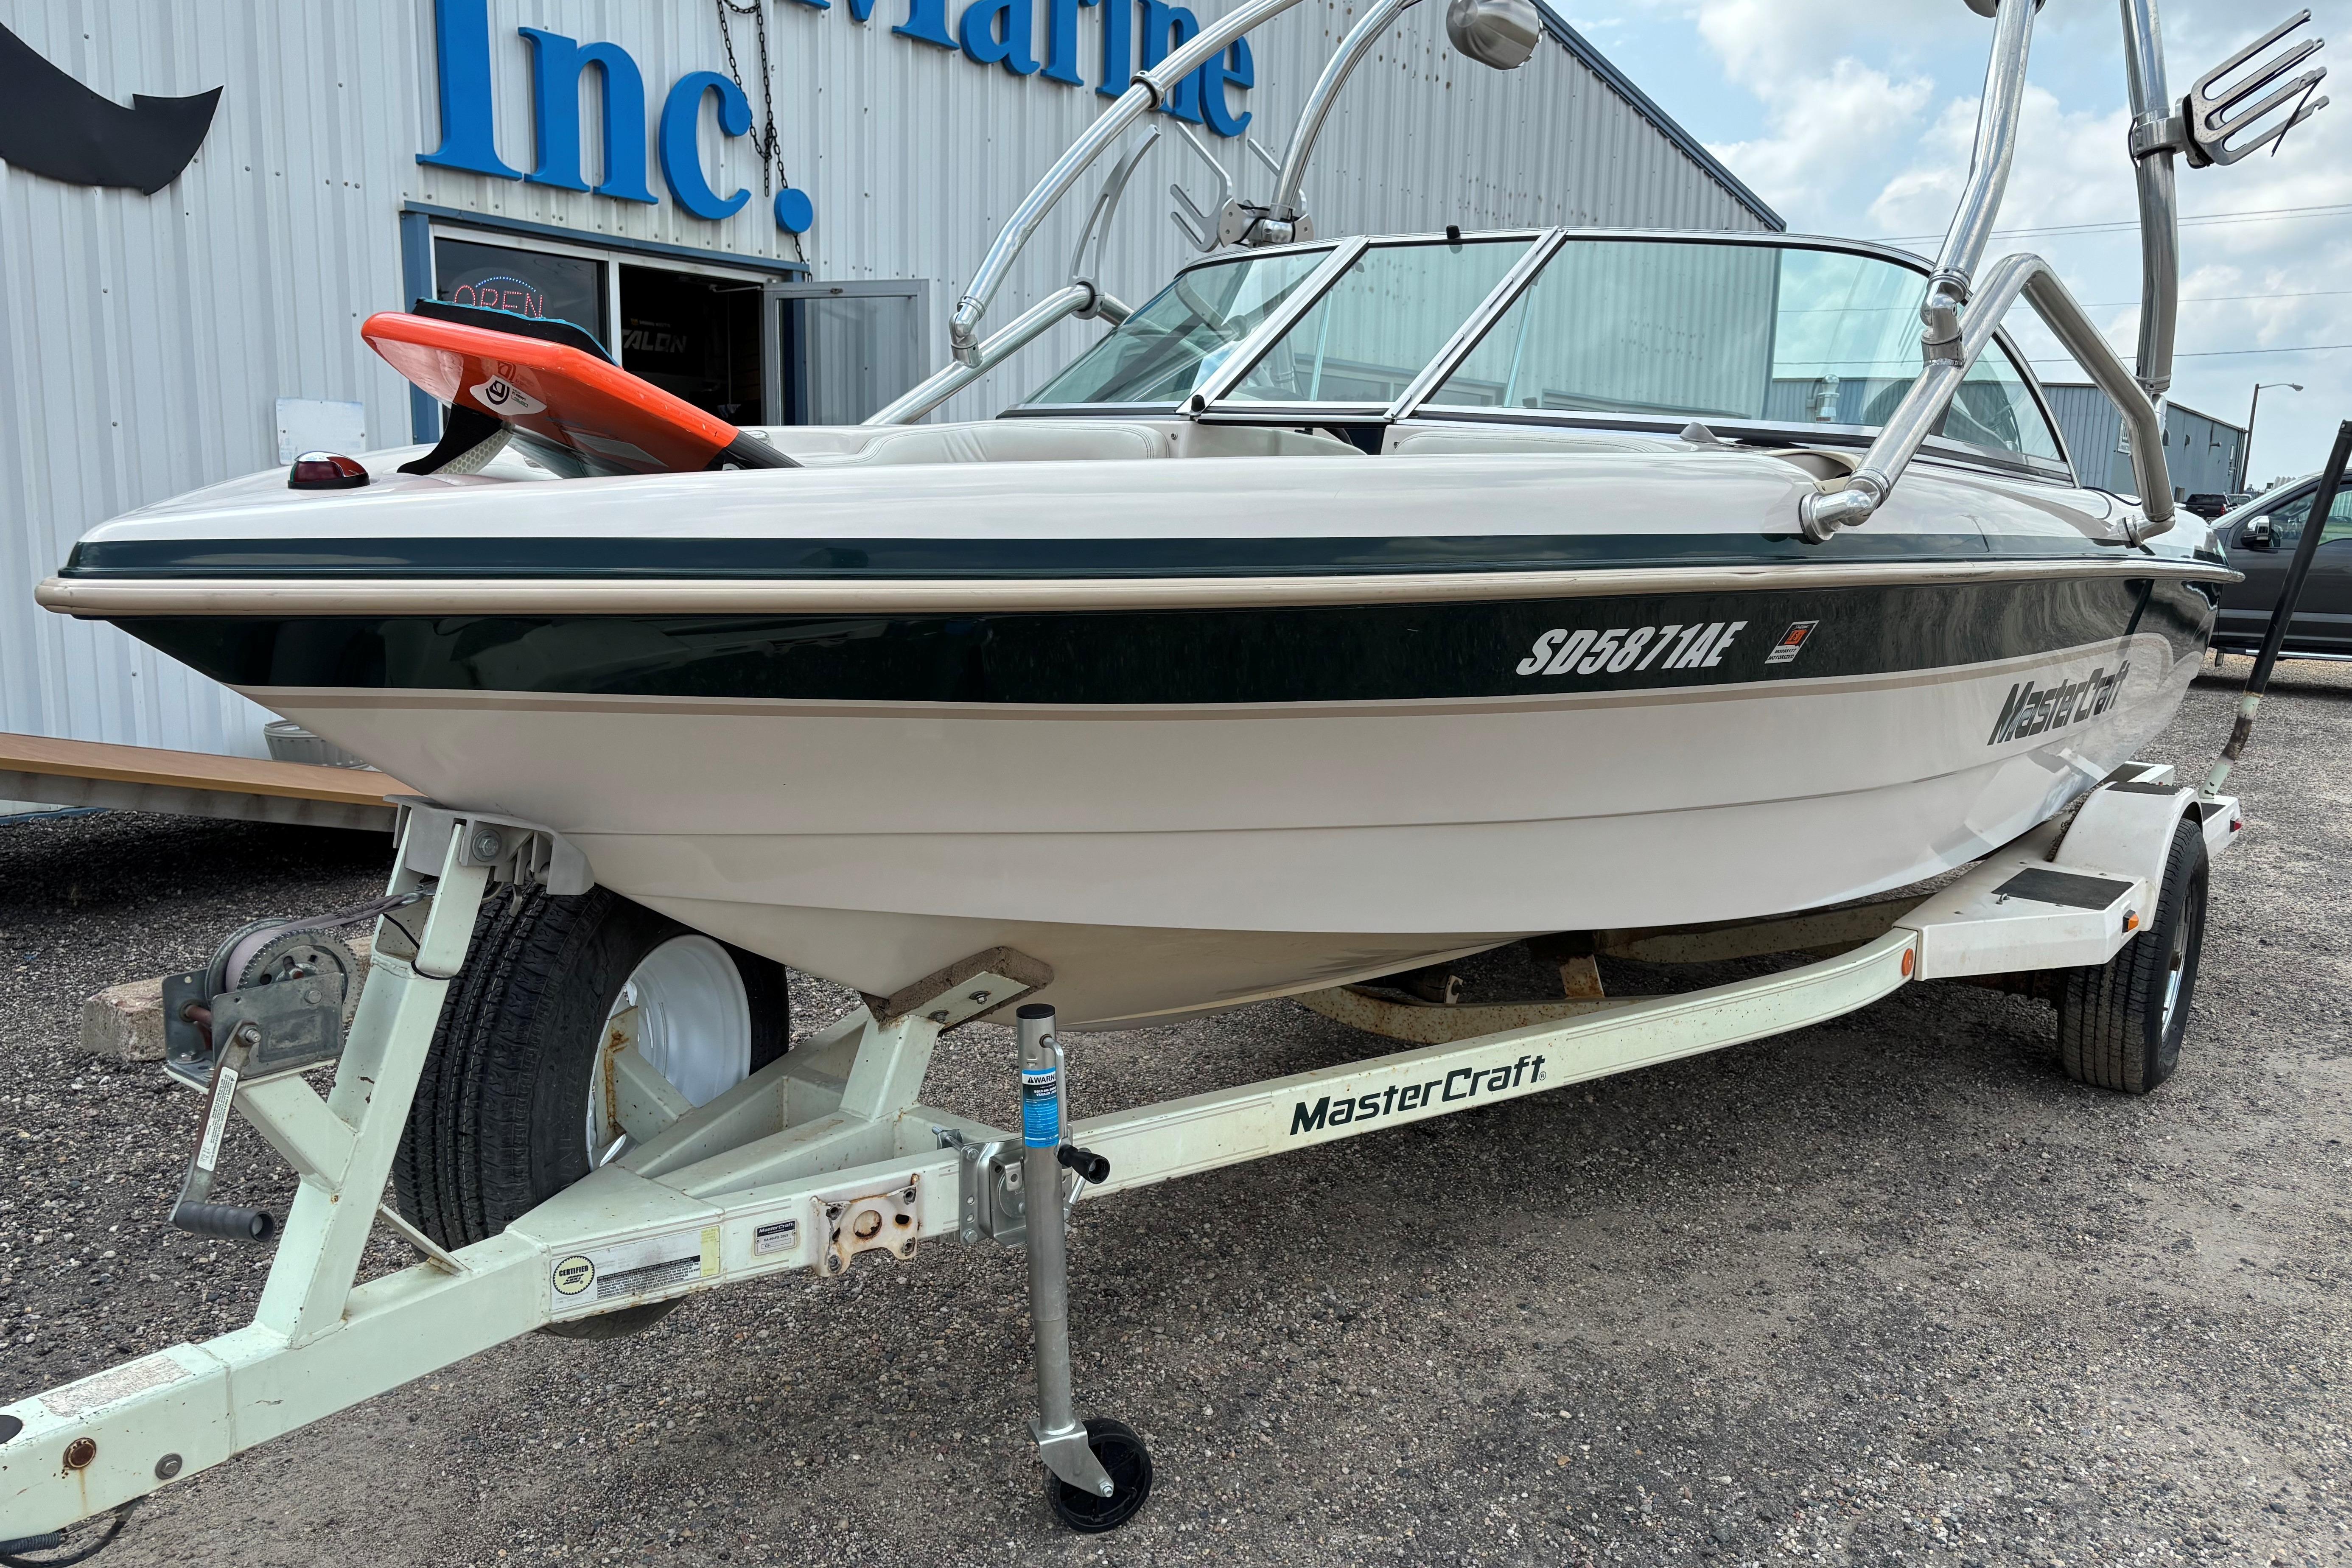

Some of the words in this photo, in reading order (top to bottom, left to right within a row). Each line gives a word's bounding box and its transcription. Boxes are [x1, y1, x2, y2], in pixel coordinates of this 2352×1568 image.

[415, 0, 813, 233] Inc.
[454, 285, 543, 318] OPEN
[1516, 620, 1748, 675] SD5871AE
[1987, 659, 2131, 746] MasterCraft
[559, 1265, 589, 1277] CERTIFIED
